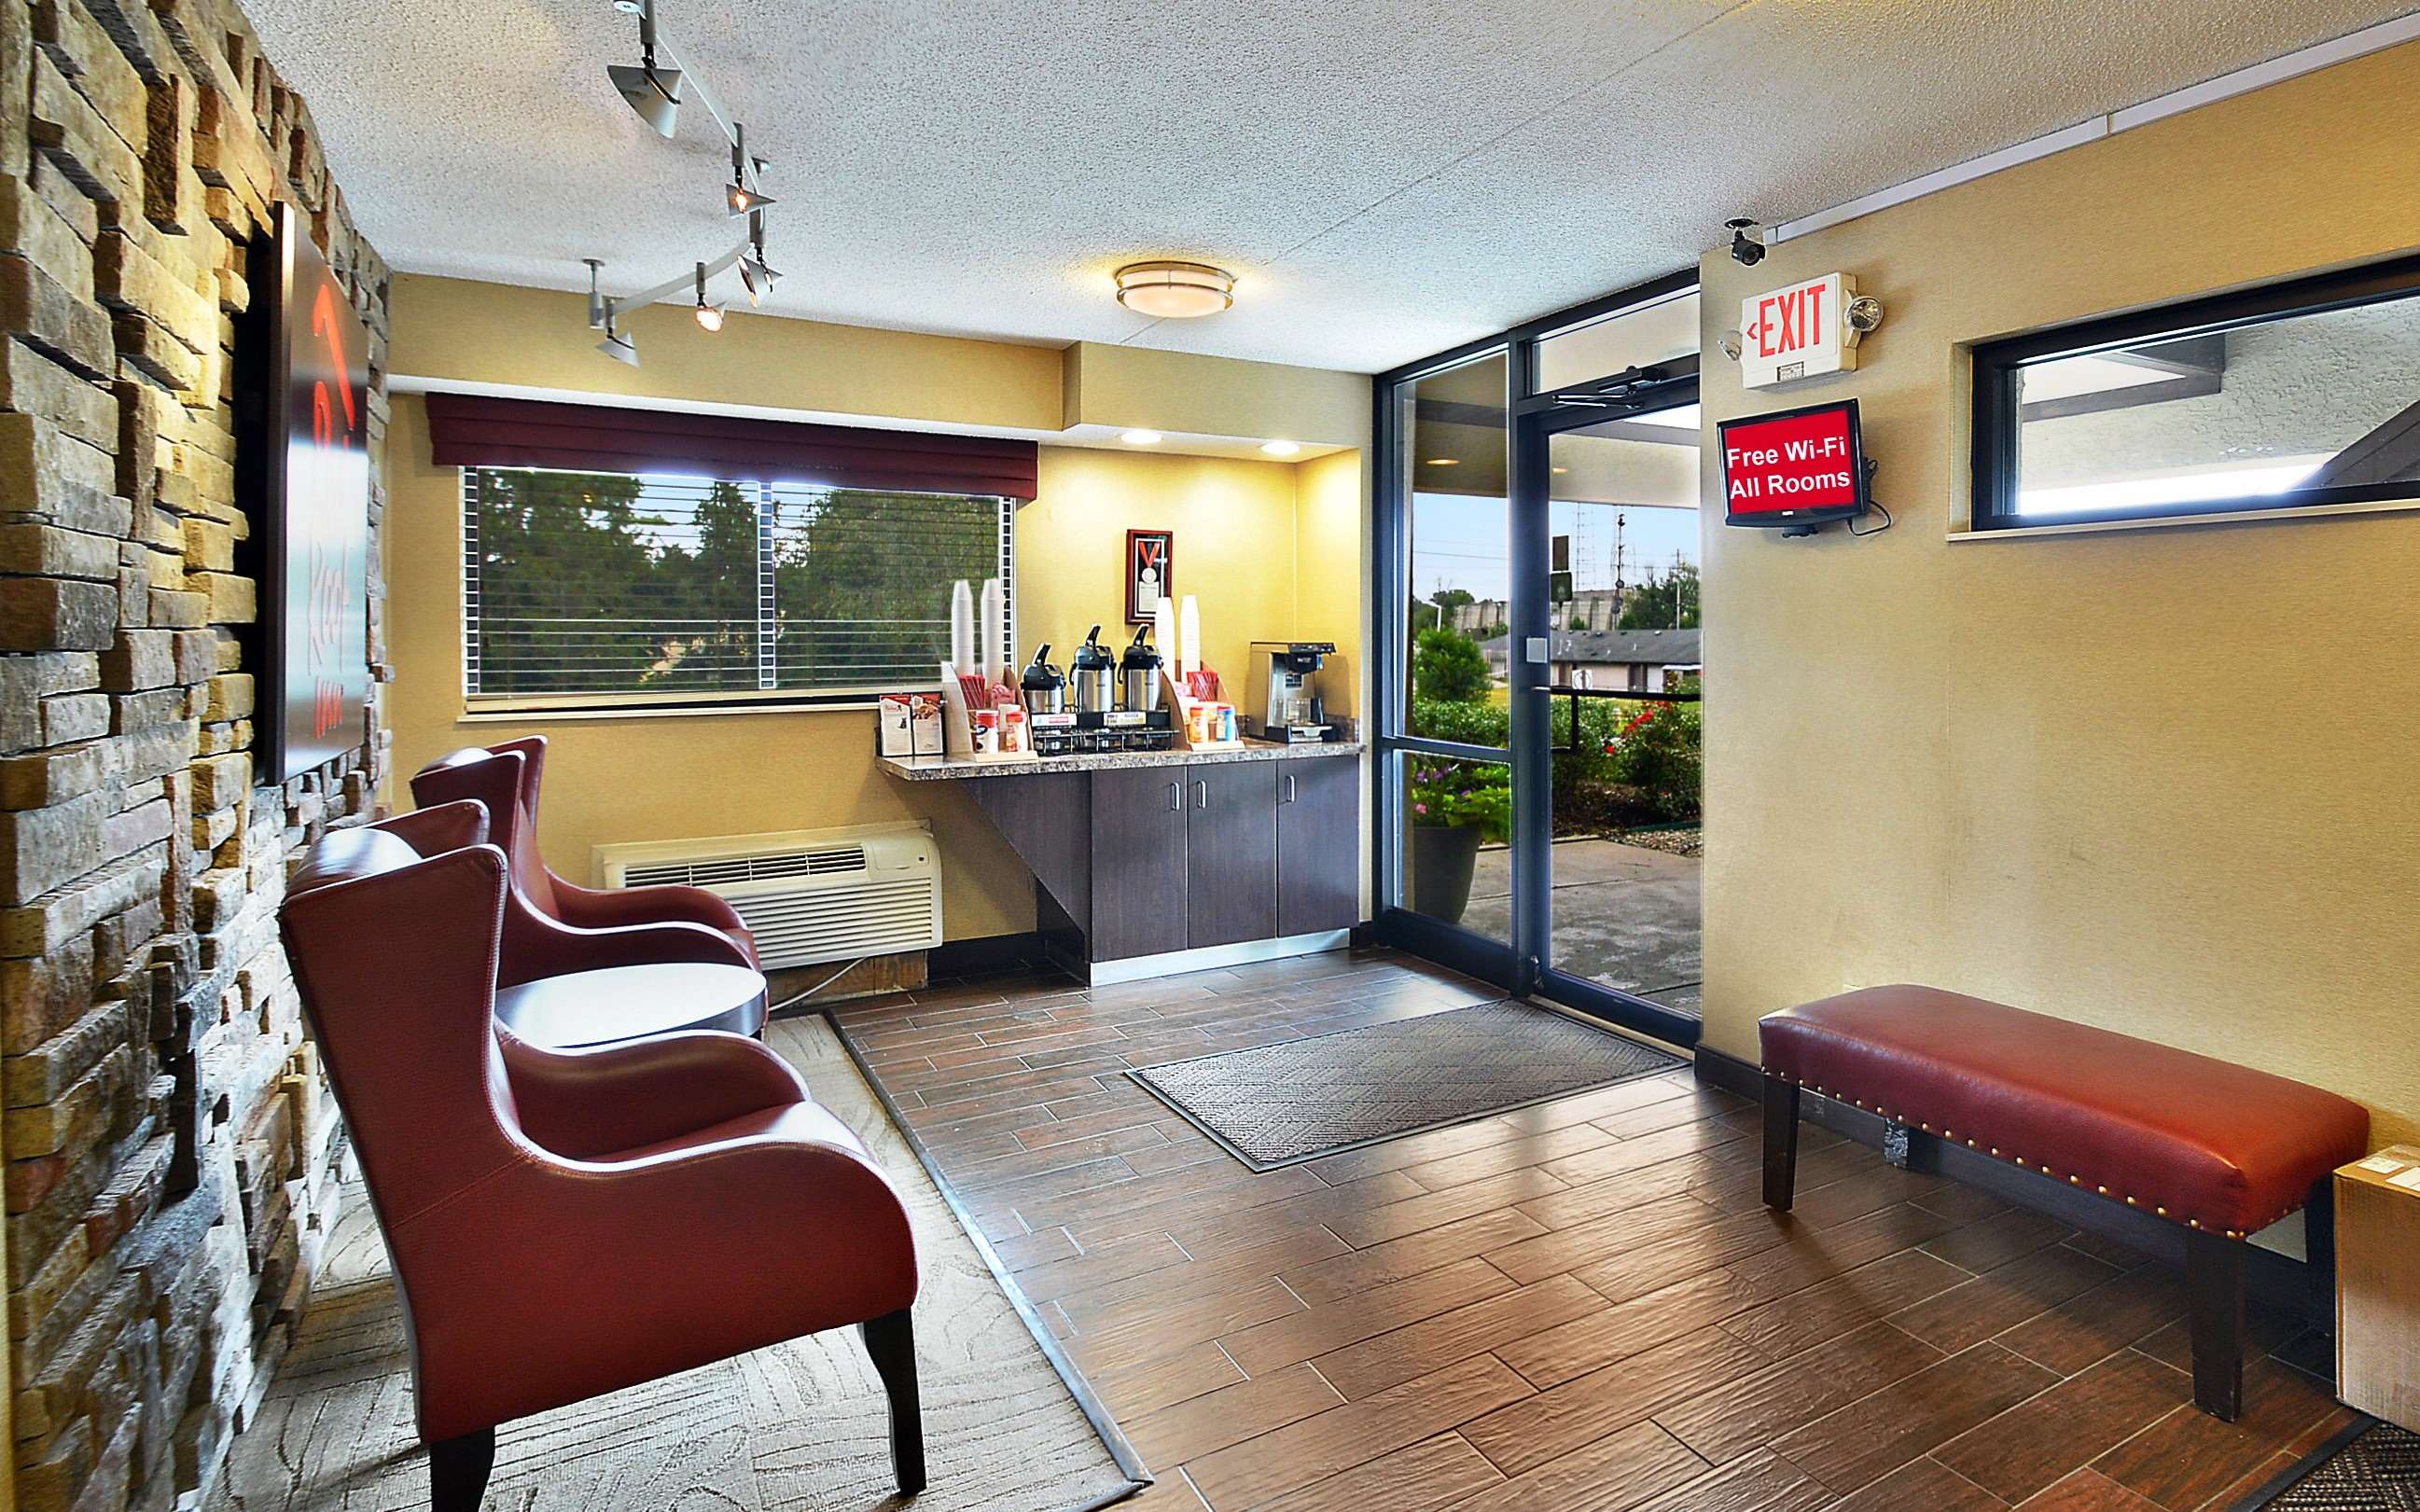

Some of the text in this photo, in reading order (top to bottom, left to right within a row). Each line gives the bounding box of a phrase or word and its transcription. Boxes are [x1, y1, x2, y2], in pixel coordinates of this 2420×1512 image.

[1759, 284, 1826, 358] EXIT
[1727, 436, 1845, 469] Free Wi-Fi
[1730, 471, 1851, 500] All Rooms
